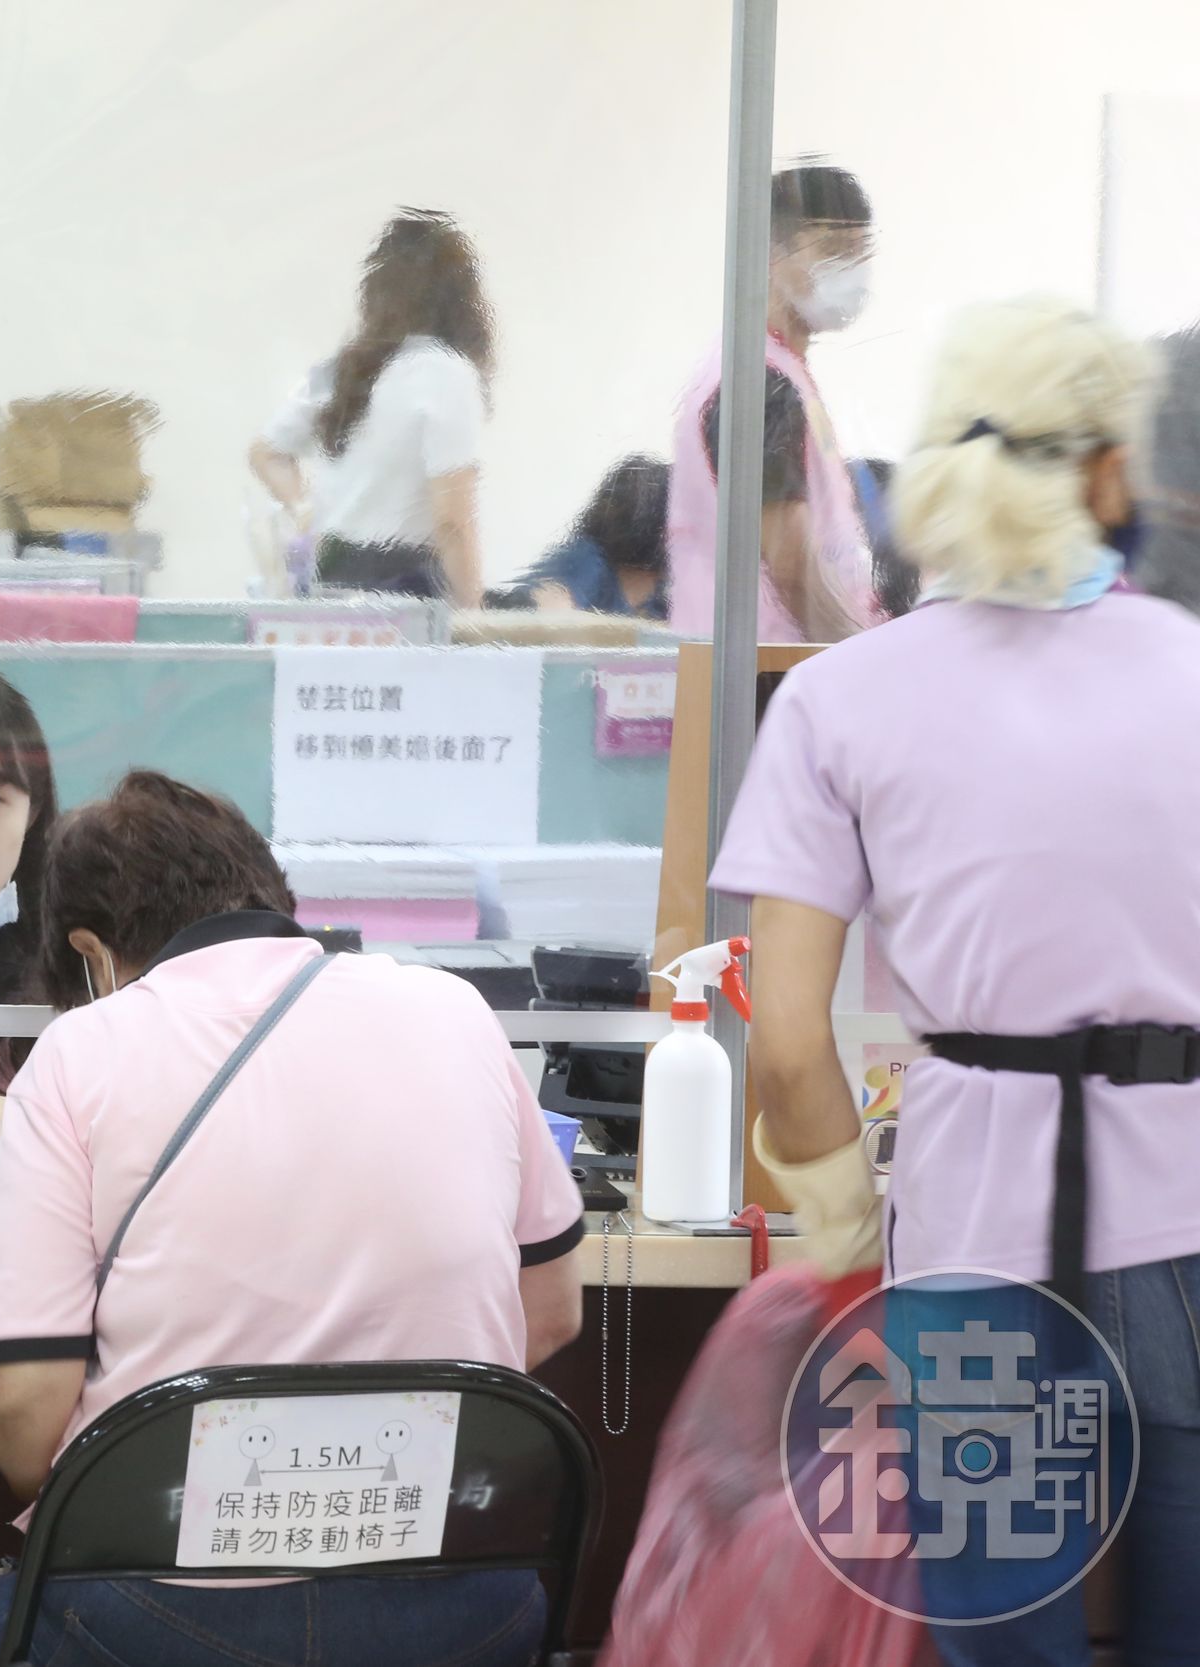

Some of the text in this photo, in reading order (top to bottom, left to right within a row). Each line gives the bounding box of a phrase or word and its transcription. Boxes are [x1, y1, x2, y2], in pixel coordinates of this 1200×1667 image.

[289, 1446, 362, 1469] 1.5M
[215, 1484, 424, 1520] 保持防疫距離
[210, 1519, 420, 1555] 請勿移動椅子
